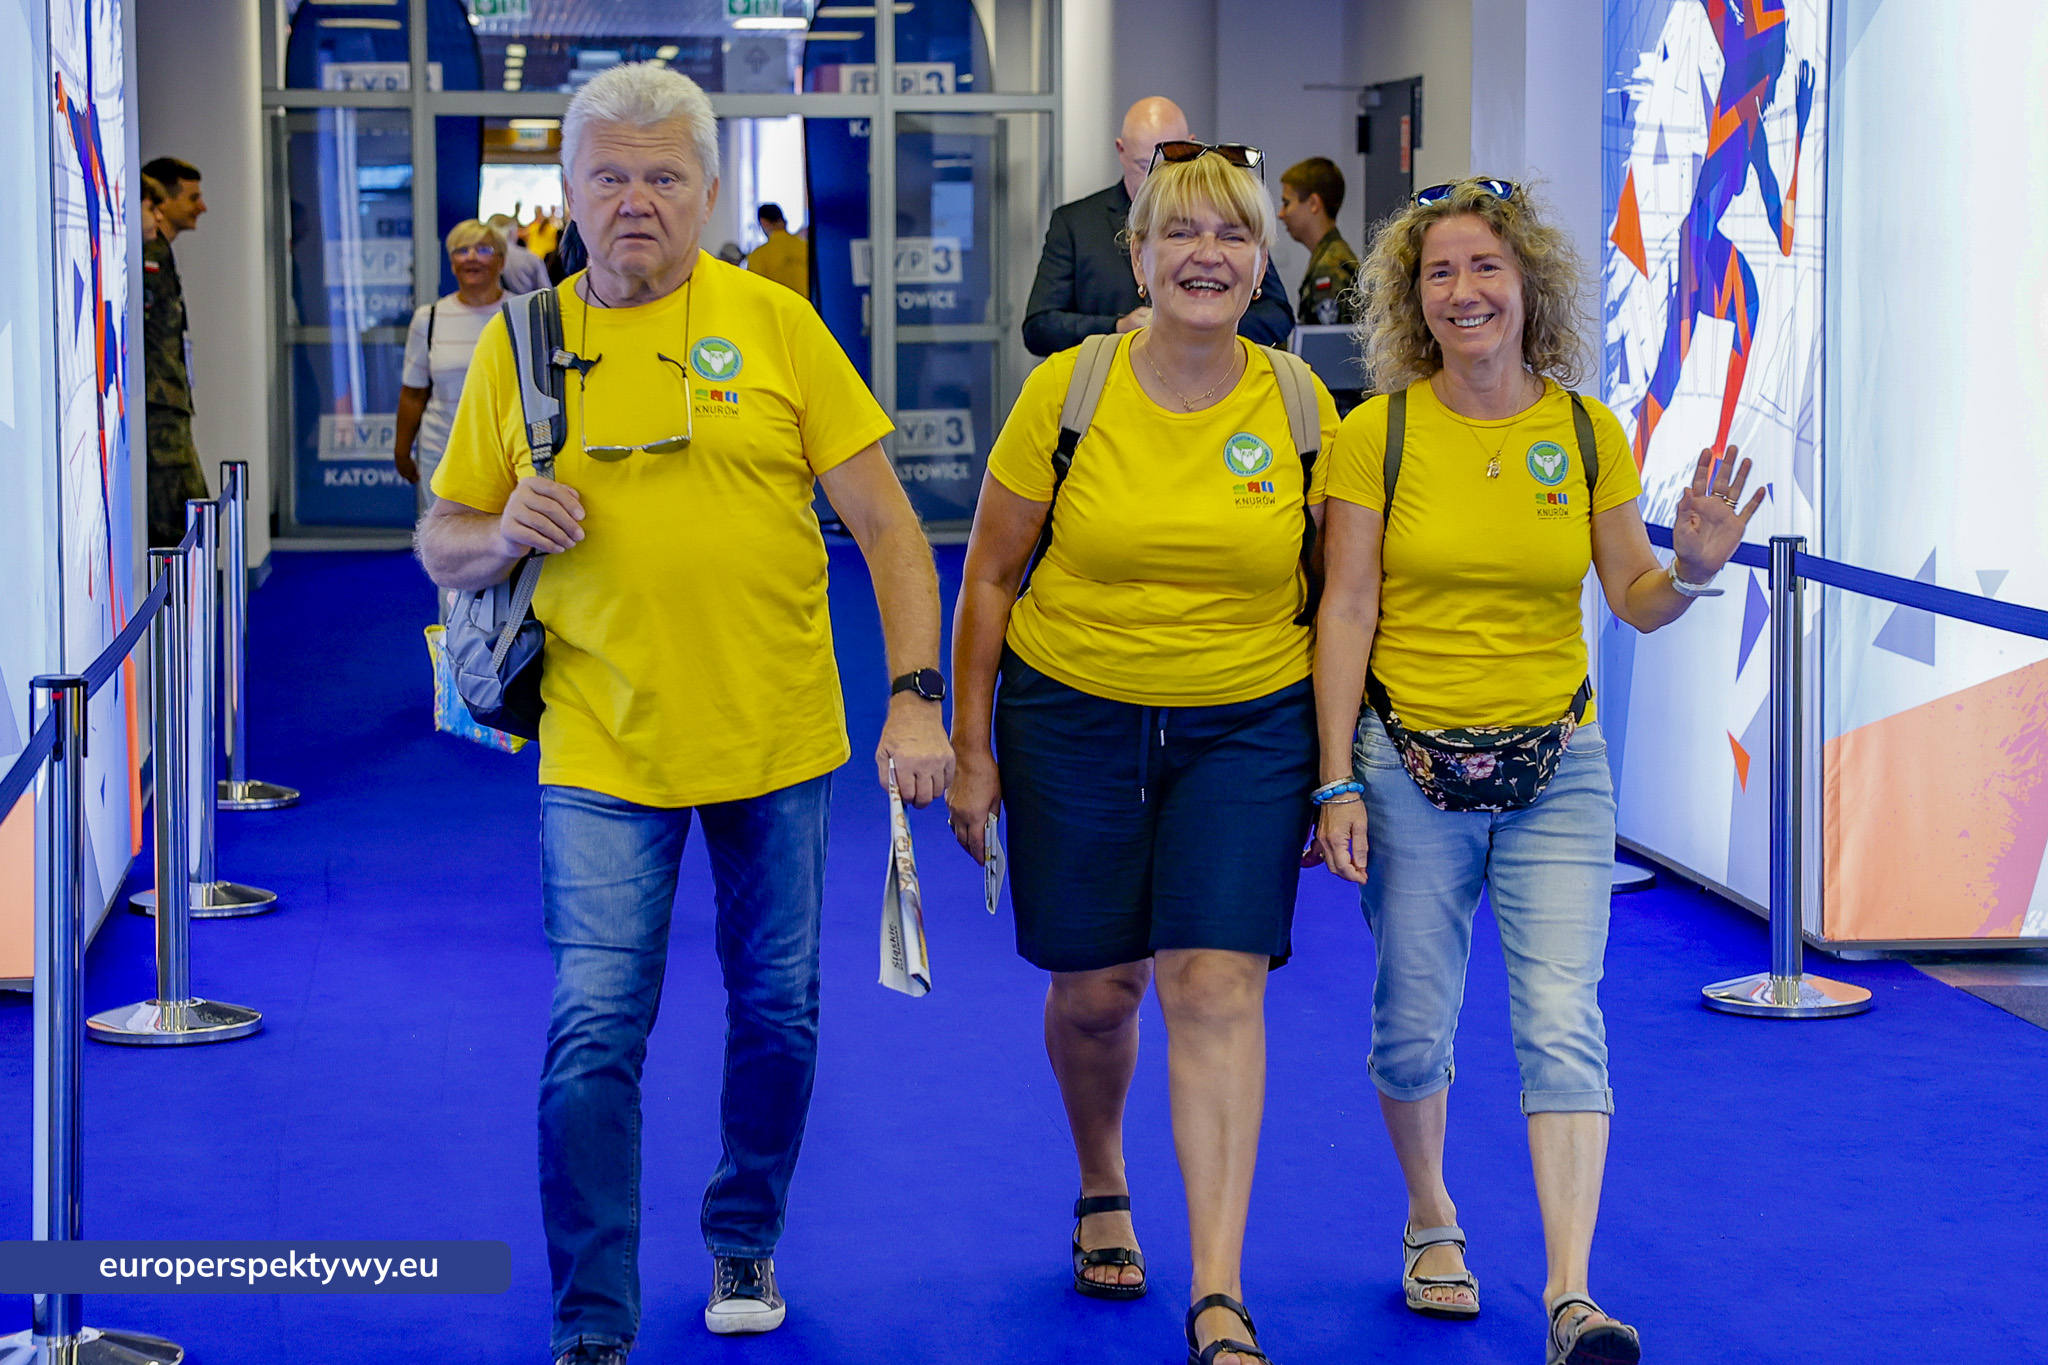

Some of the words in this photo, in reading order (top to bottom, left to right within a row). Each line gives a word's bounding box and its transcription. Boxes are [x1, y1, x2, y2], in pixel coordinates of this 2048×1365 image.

[933, 246, 953, 275] 3
[945, 416, 966, 447] 3
[1235, 496, 1275, 505] KNURÓW
